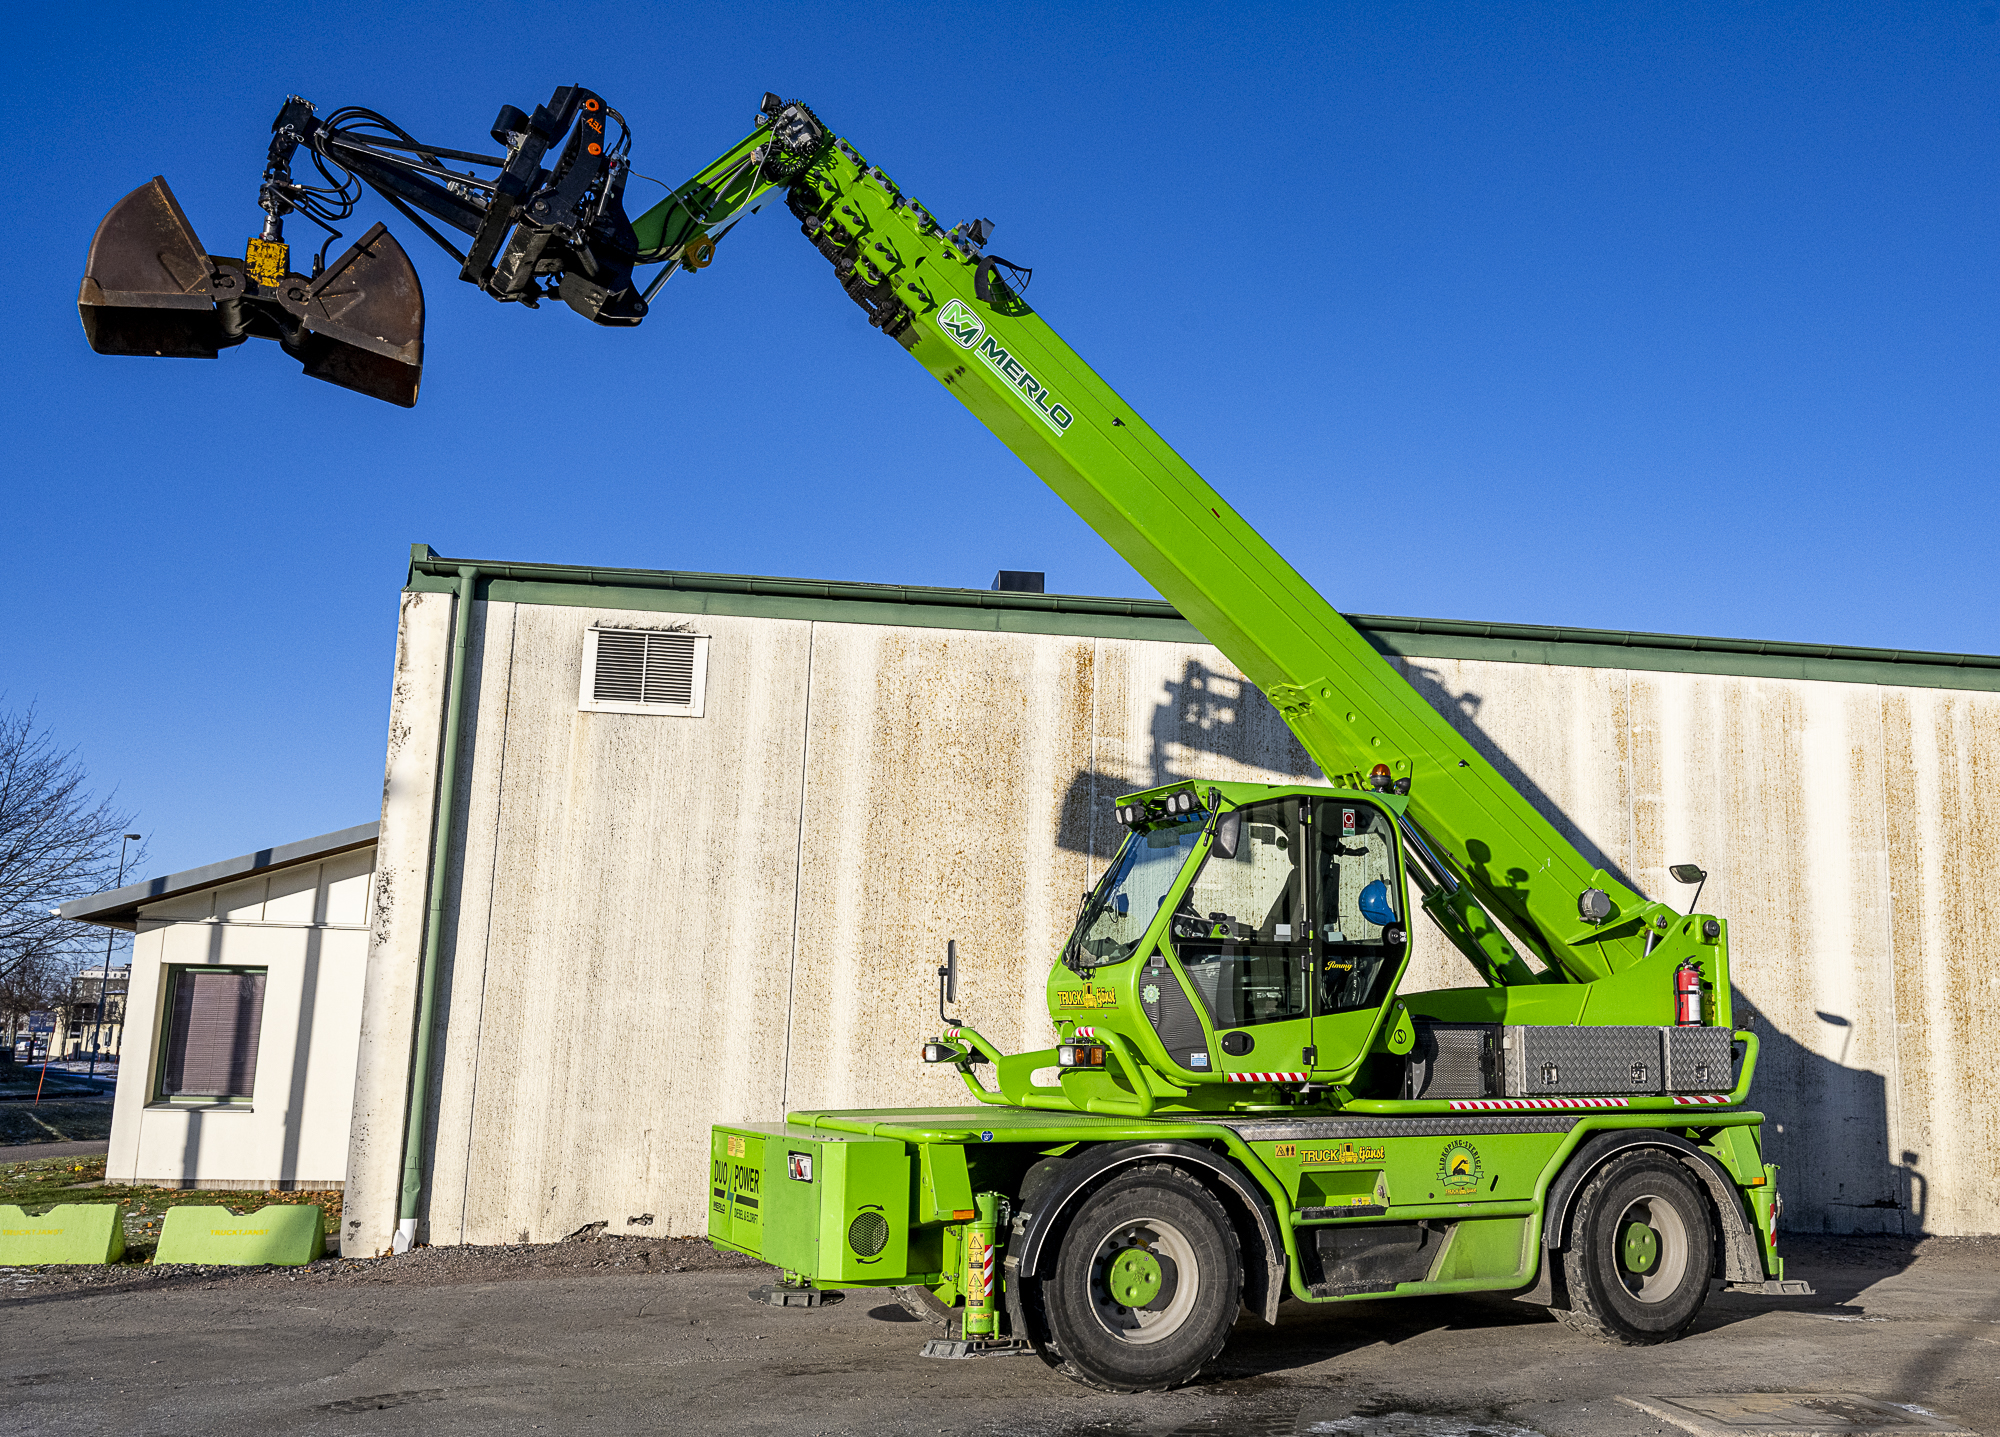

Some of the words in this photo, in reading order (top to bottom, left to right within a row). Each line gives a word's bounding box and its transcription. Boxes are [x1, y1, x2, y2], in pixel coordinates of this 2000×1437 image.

[980, 334, 1074, 430] MERLO
[1324, 960, 1353, 972] Jimmy
[1057, 990, 1084, 1005] TRUCK
[1096, 987, 1116, 1008] tjänst
[1300, 1149, 1340, 1162] TRUCK
[1358, 1145, 1385, 1163] tjänst
[1465, 1140, 1482, 1170] SVERIGE
[714, 1159, 728, 1185] DUO
[734, 1164, 760, 1194] POWER
